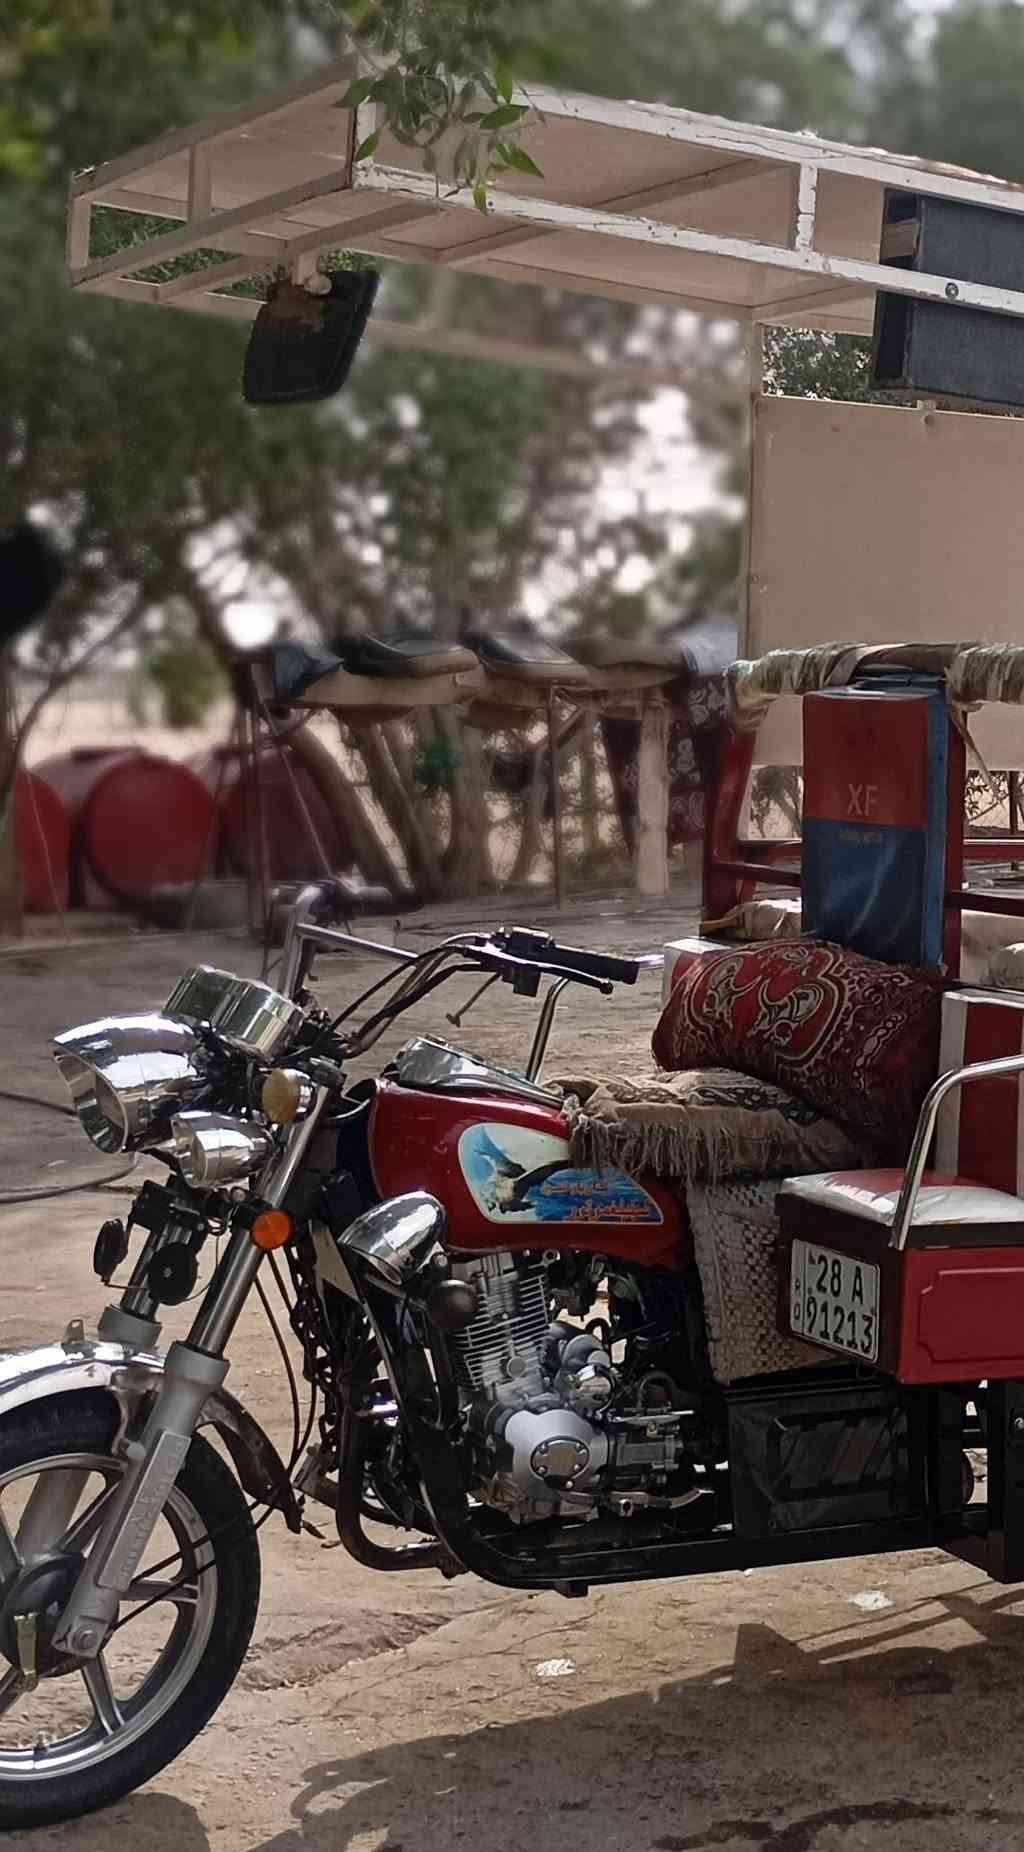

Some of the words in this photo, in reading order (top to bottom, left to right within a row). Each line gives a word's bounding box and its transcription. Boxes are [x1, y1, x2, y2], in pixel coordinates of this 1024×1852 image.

[848, 784, 878, 816] XF
[817, 1254, 841, 1297] 28
[852, 1266, 864, 1305] A
[807, 1296, 873, 1352] 91213
